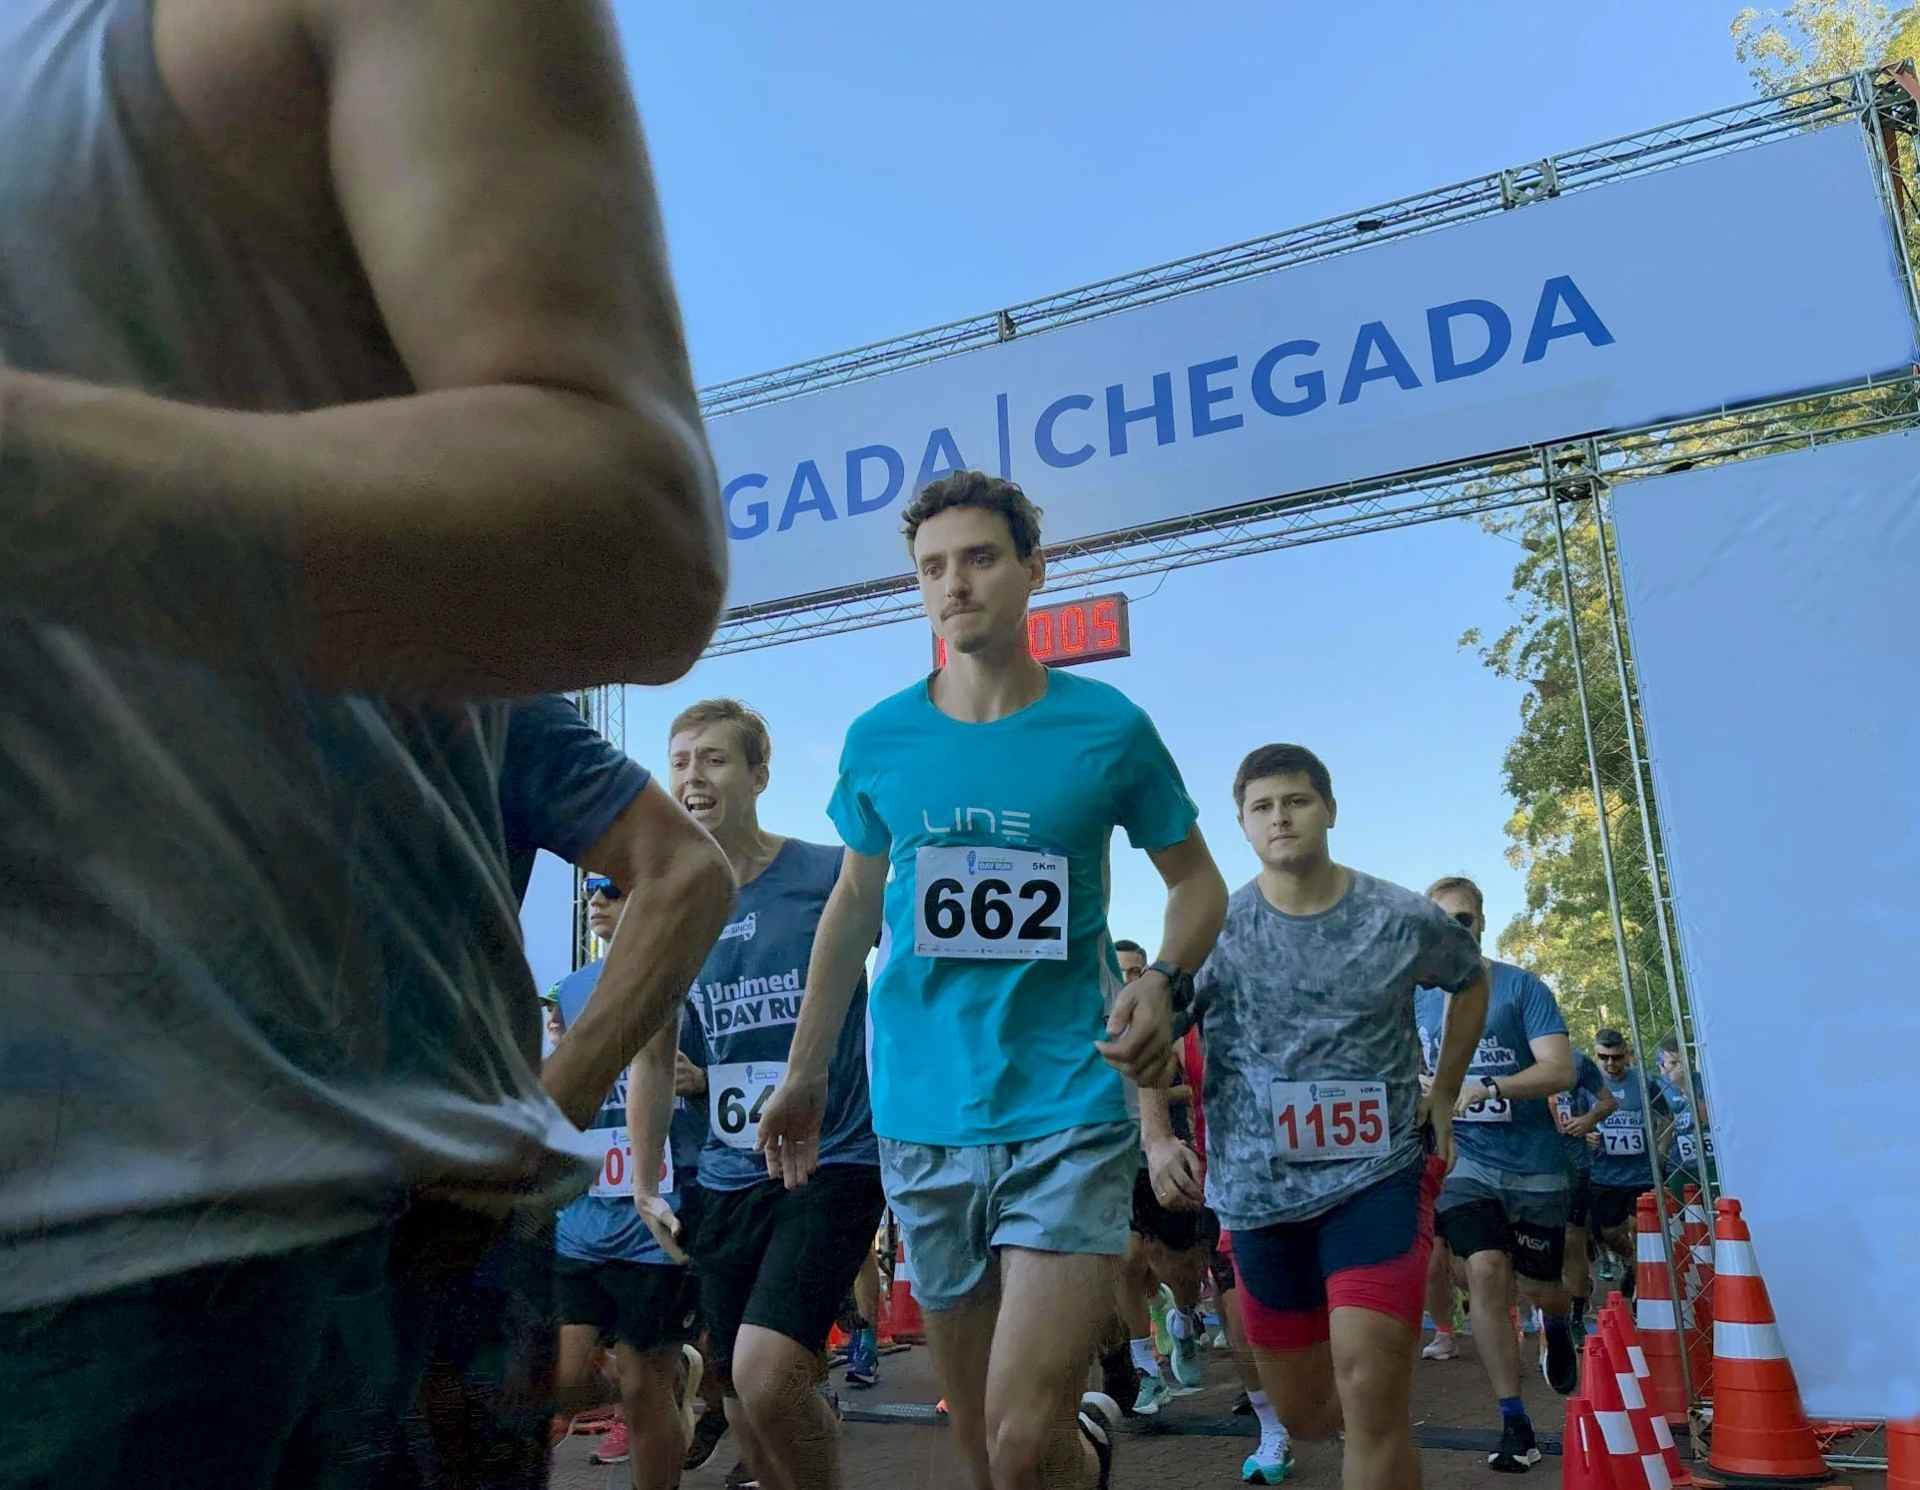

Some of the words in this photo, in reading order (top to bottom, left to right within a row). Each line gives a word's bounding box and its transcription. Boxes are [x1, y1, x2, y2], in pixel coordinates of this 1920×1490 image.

[1034, 275, 1616, 469] CHEGADA
[924, 878, 1062, 940] 662
[706, 968, 799, 1003] Unimed
[715, 1000, 763, 1030] DAY
[1278, 1100, 1383, 1150] 1155
[1606, 1134, 1642, 1150] 713
